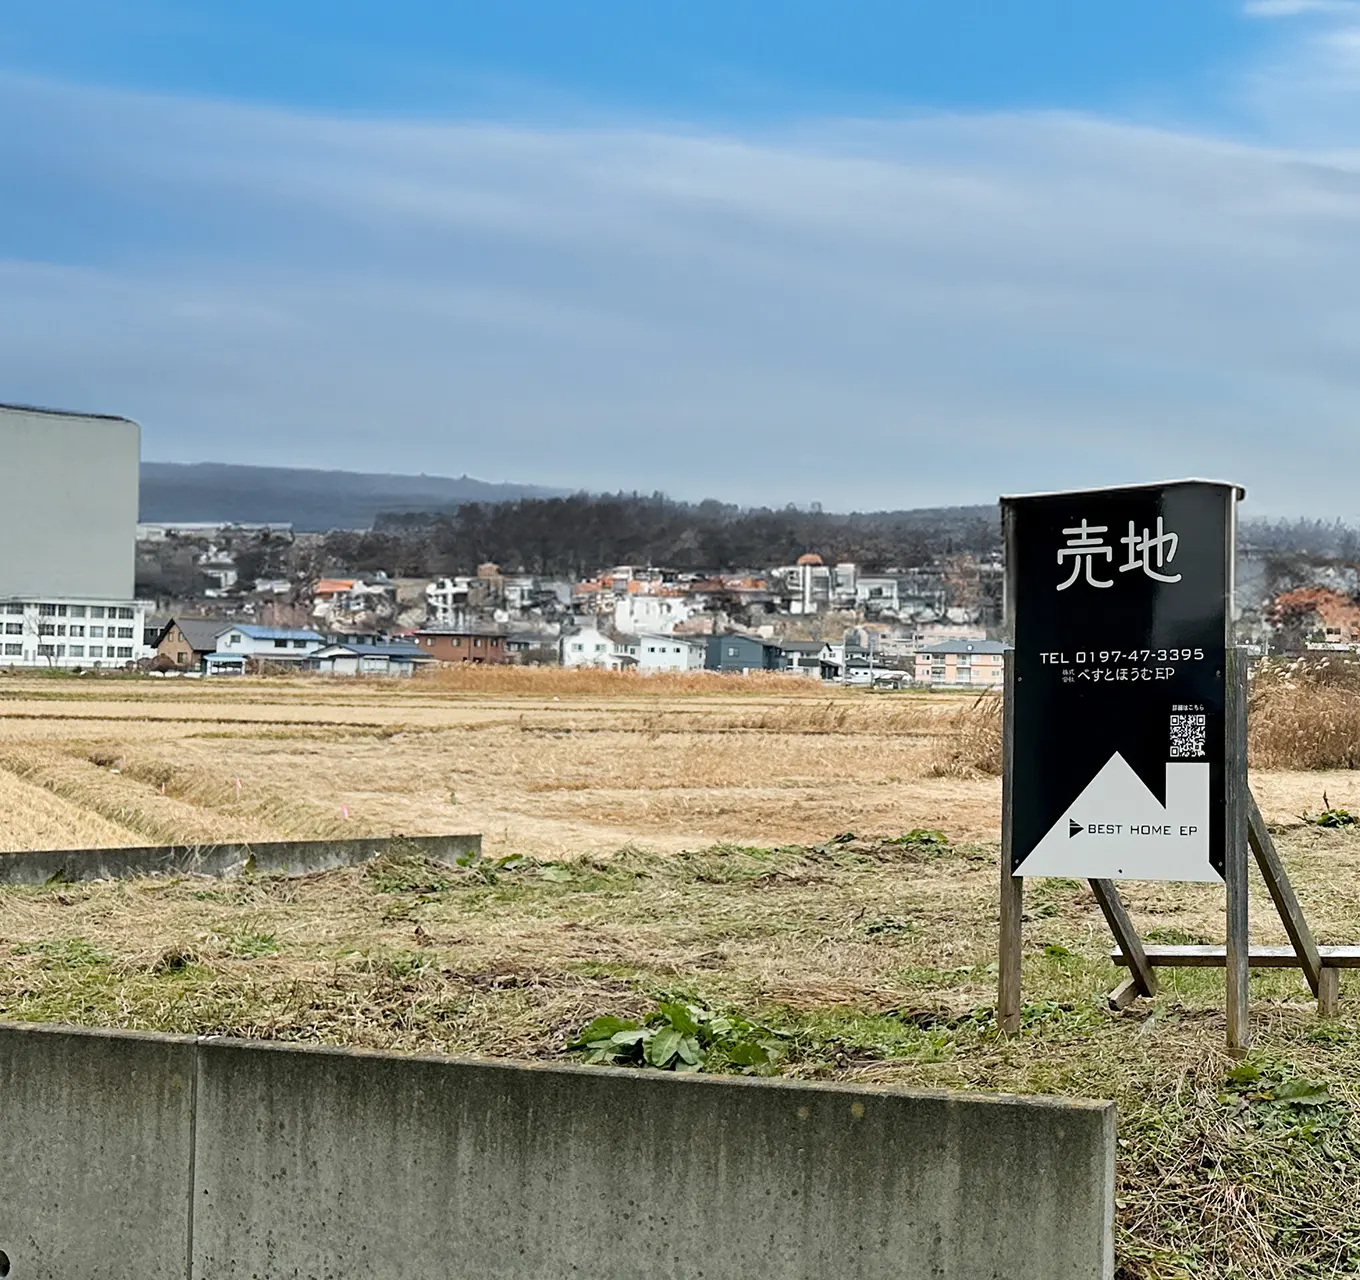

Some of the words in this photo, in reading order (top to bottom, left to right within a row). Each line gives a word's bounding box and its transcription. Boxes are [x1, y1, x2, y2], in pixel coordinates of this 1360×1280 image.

[1056, 516, 1182, 591] 売地
[1039, 652, 1070, 664] TEL
[1076, 648, 1204, 663] 0197-47-3395
[1088, 824, 1123, 834] BEST
[1130, 825, 1171, 836] HOME
[1179, 826, 1198, 836] EP
